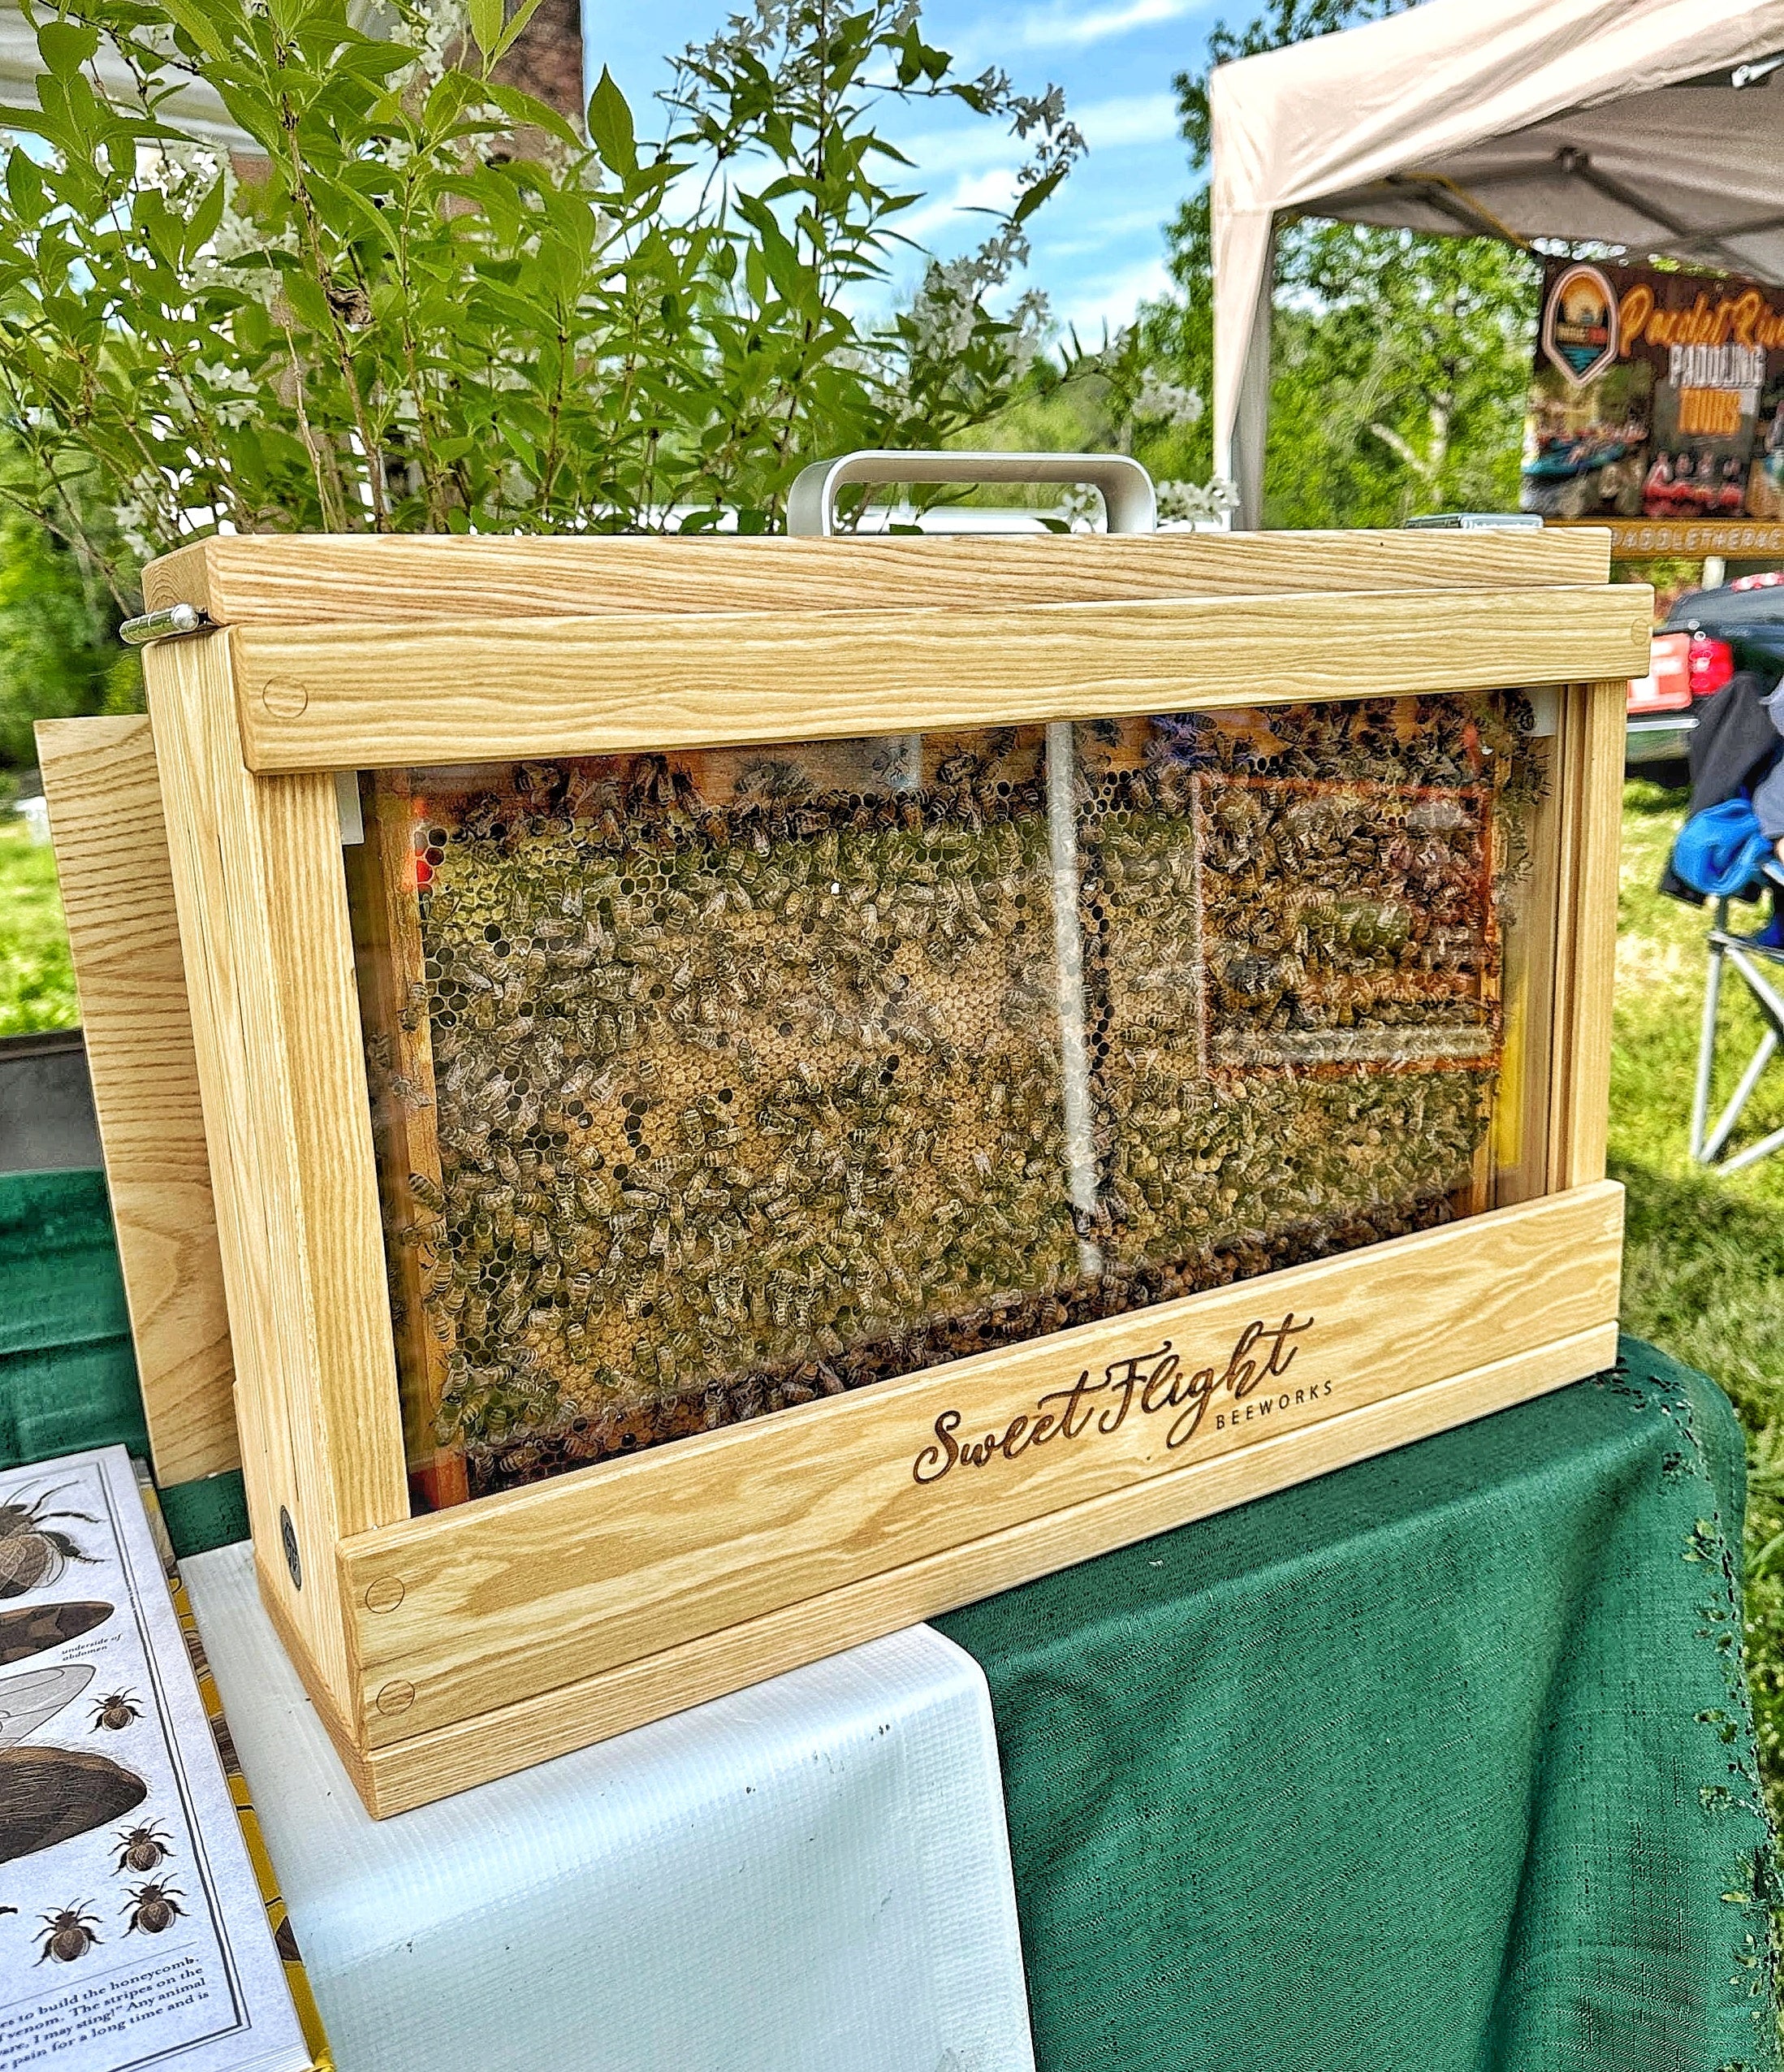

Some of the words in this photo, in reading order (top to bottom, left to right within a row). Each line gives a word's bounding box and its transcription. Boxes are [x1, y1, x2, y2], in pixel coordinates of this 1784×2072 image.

[913, 1370, 1111, 1485] Sweet
[1099, 1313, 1314, 1449] Flight
[1216, 1380, 1333, 1430] BEEWORKS
[62, 1637, 108, 1655] underside
[110, 1633, 123, 1642] of
[63, 1646, 107, 1661] abdomen
[7, 2017, 65, 2039] venom.
[68, 2003, 101, 2017] The
[104, 1984, 153, 2005] stripes
[156, 1977, 177, 1988] on
[180, 1967, 203, 1979] the
[19, 2012, 34, 2022] to
[38, 1994, 79, 2014] build
[83, 1988, 106, 2000] the
[110, 1957, 200, 1991] honeycomb.
[33, 2035, 40, 2044] I
[44, 2026, 73, 2041] may
[127, 1996, 155, 2013] Any
[158, 1977, 206, 2001] animal
[13, 2048, 47, 2070] pain
[52, 2038, 76, 2053] for
[91, 2020, 127, 2038] long
[129, 2007, 164, 2024] time
[167, 1994, 195, 2011] and
[197, 1991, 210, 2000] is
